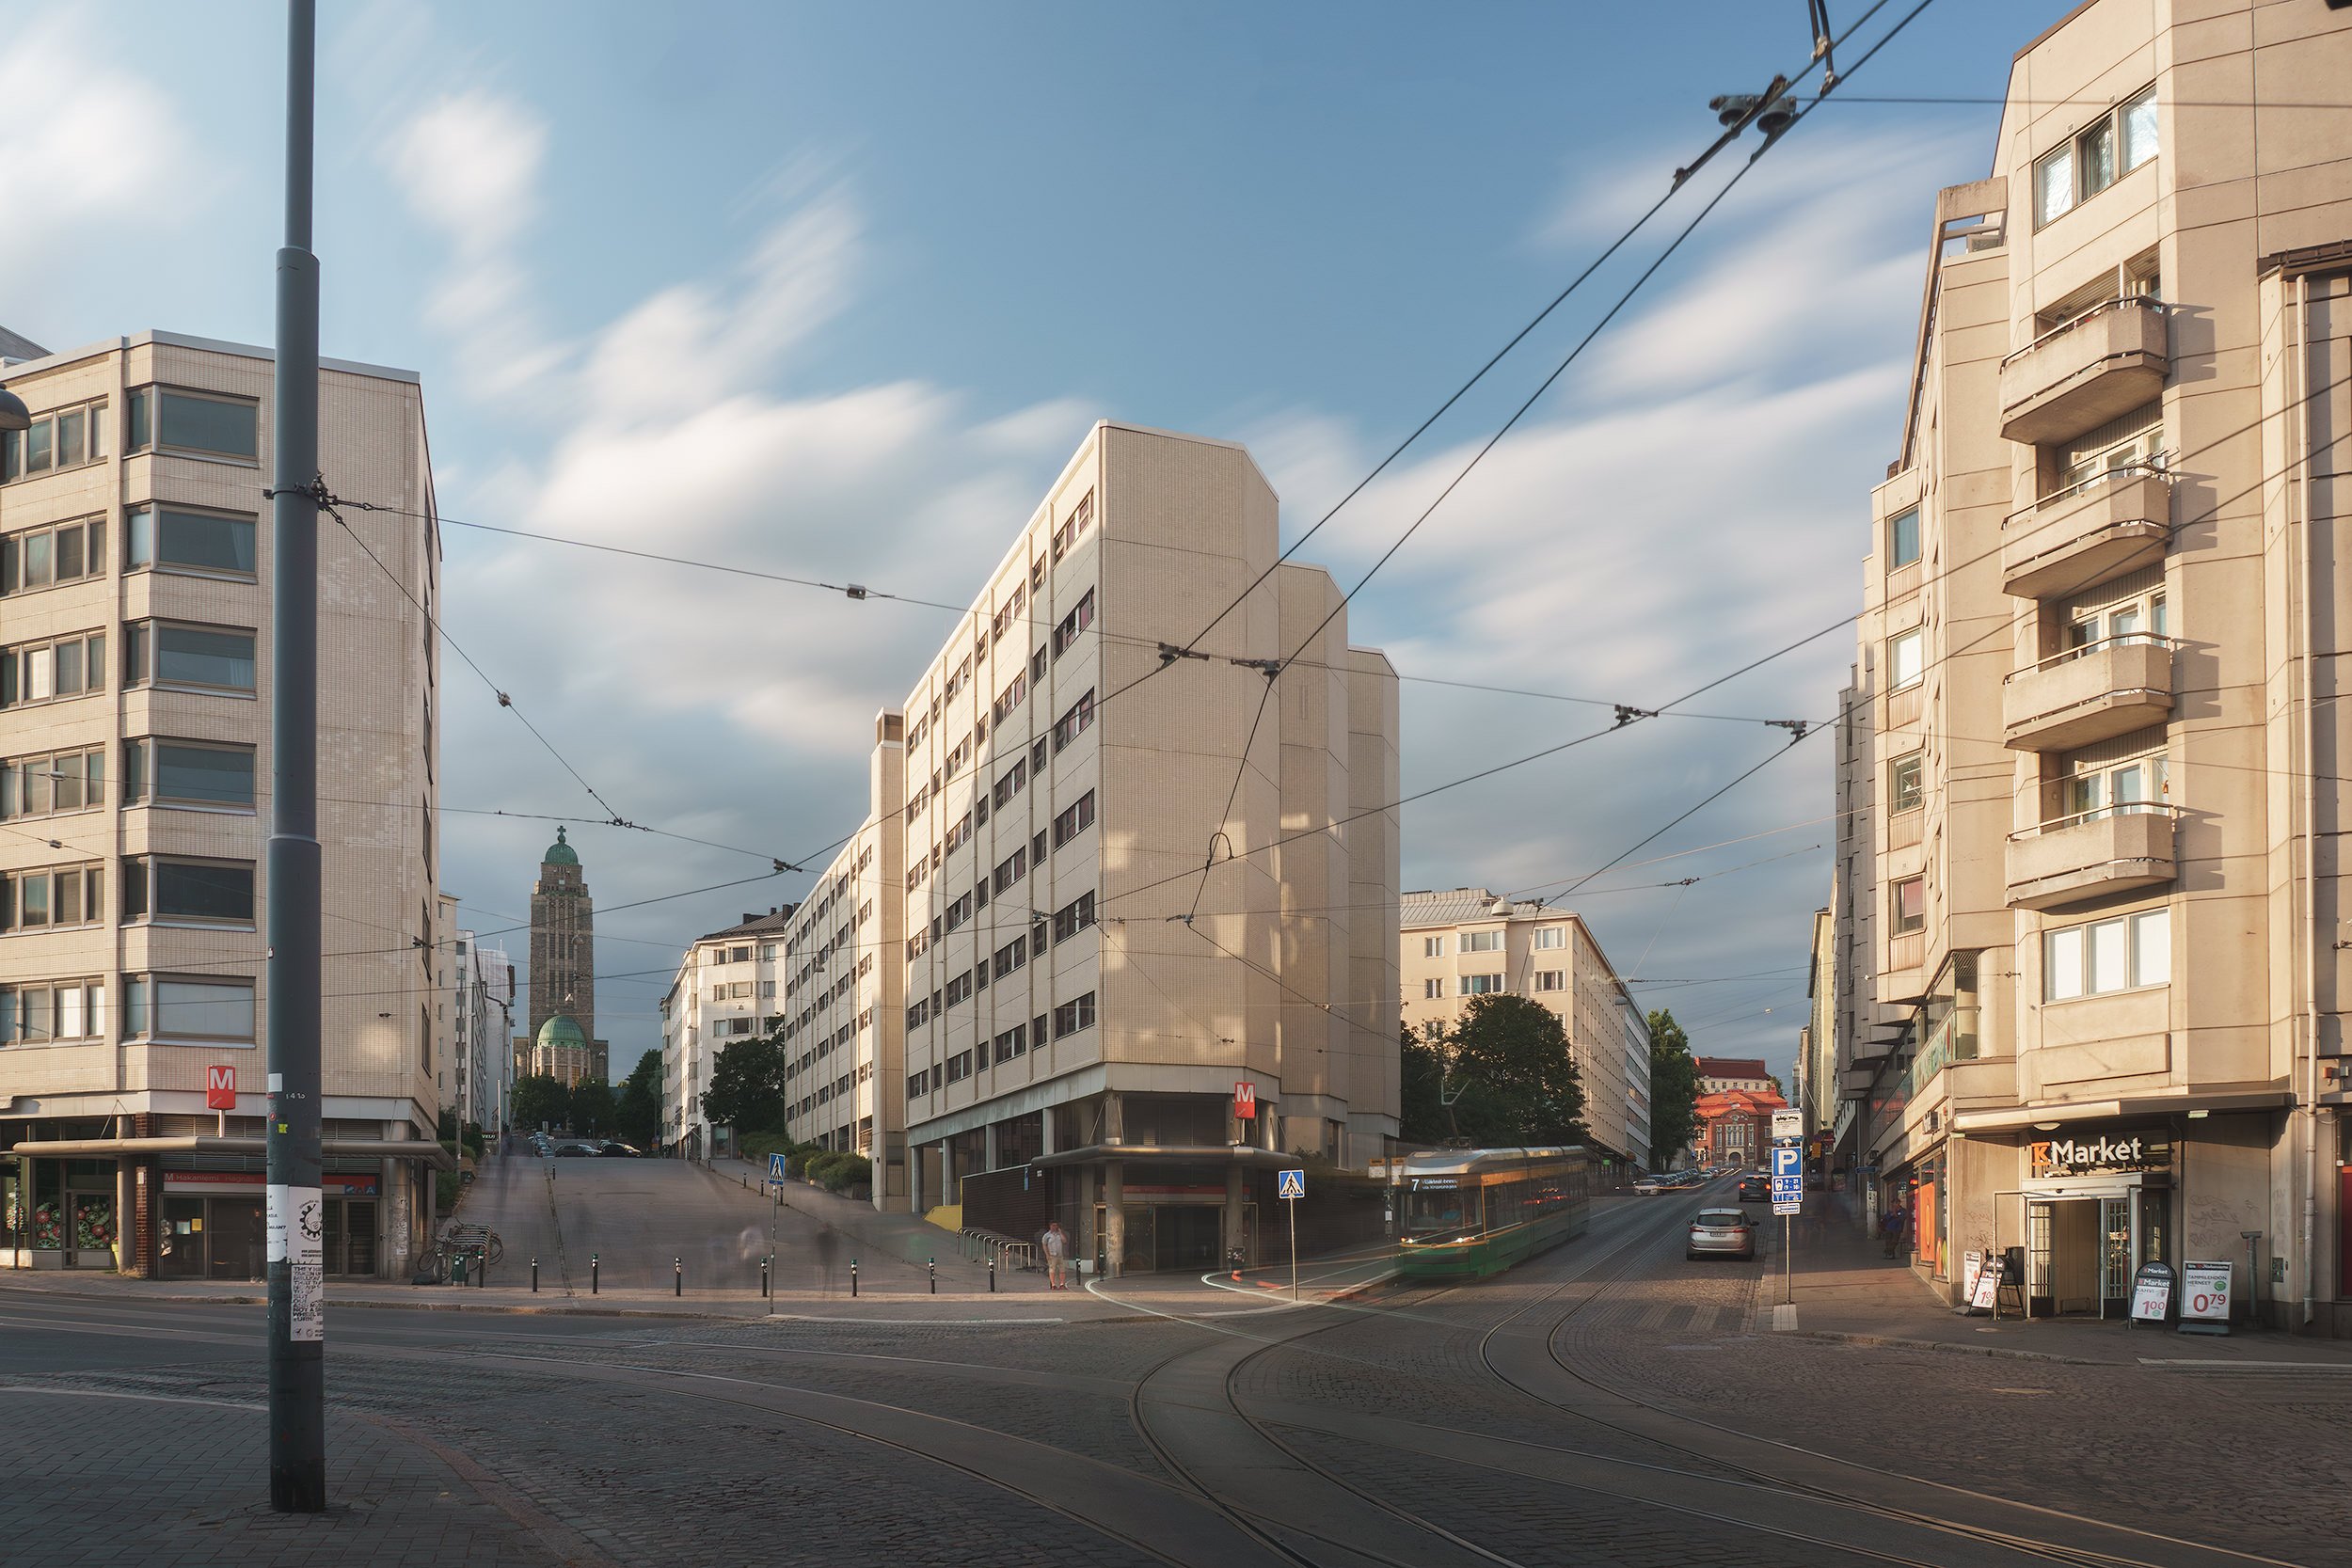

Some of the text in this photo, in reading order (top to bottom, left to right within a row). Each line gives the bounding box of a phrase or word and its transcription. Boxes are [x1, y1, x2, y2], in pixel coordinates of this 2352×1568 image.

[210, 1068, 234, 1090] M
[1236, 1084, 1254, 1103] M
[1778, 1149, 1798, 1175] P
[165, 1173, 174, 1181] M
[1411, 1179, 1420, 1192] 7
